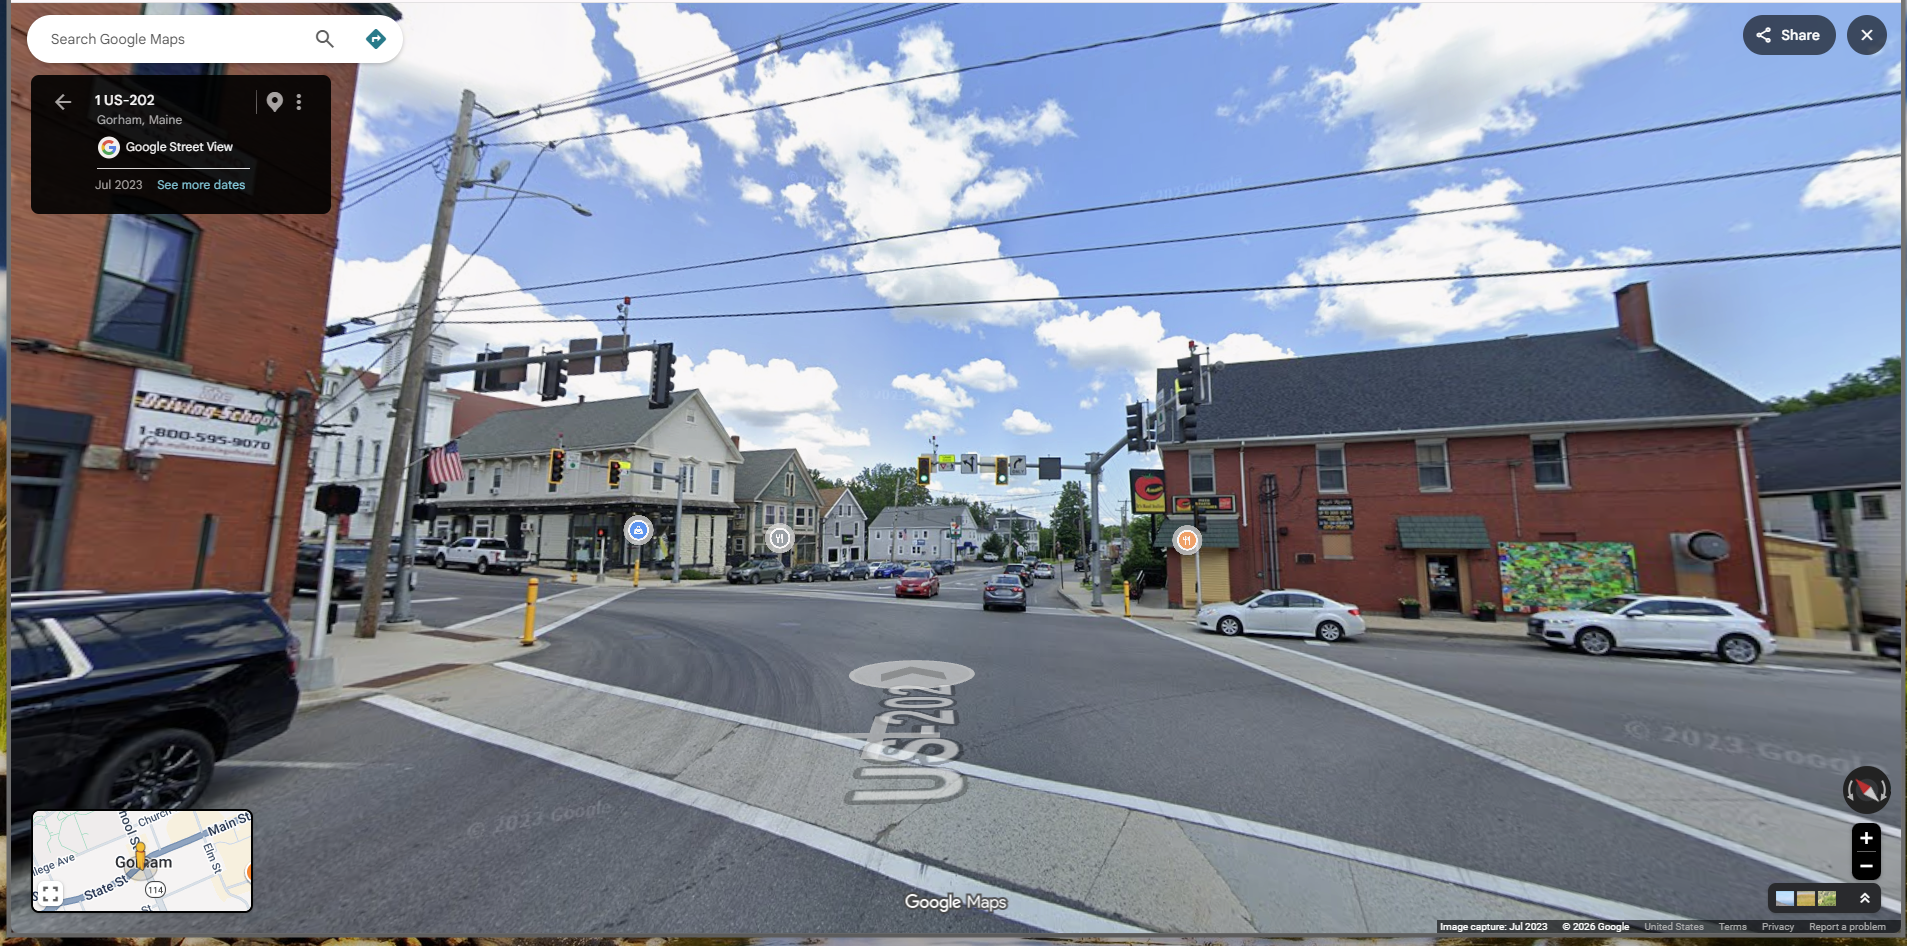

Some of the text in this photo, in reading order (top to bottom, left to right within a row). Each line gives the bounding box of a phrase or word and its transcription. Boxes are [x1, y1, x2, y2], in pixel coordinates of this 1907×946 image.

[199, 384, 233, 404] The
[140, 392, 282, 427] Driving School
[139, 425, 271, 450] 1-800-595-9070
